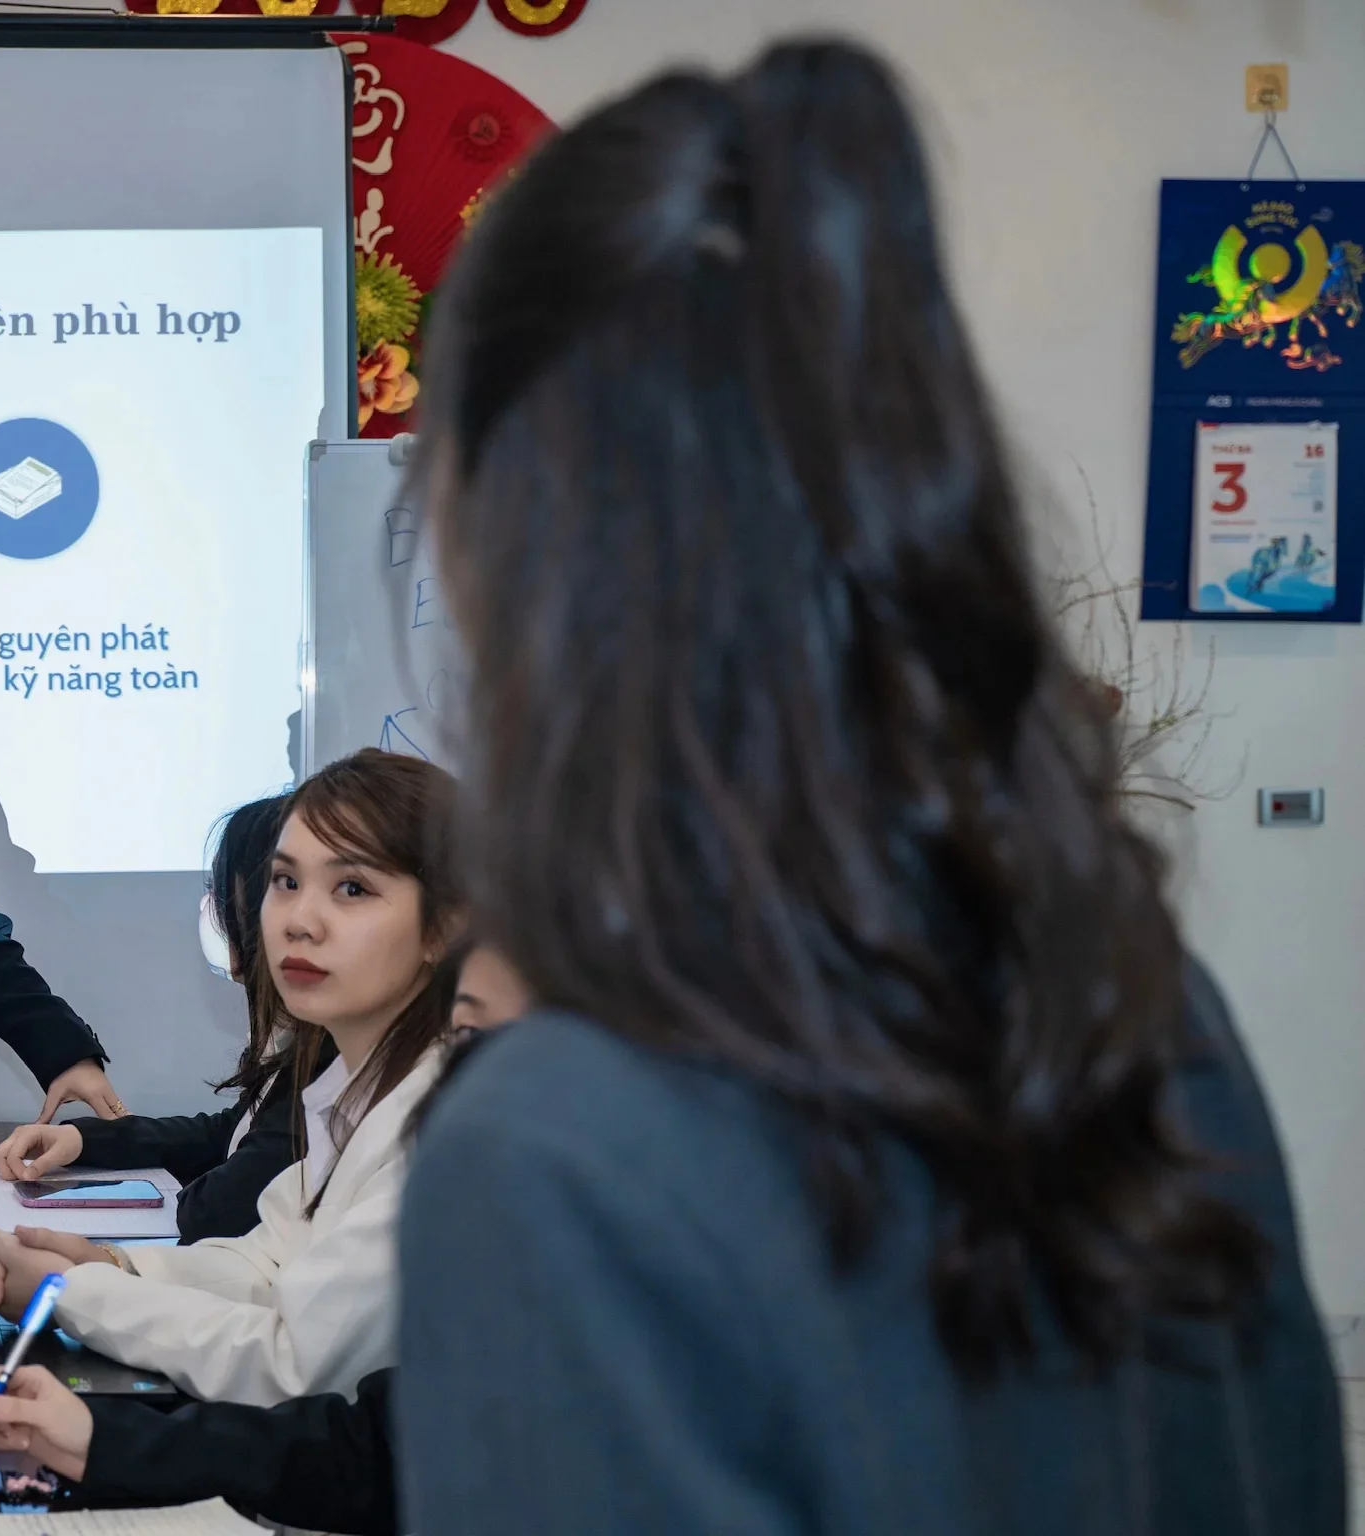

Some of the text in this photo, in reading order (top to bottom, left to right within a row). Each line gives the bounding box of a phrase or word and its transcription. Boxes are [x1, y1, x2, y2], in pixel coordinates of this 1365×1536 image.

[52, 302, 140, 344] phù
[156, 303, 242, 343] hợp
[1304, 443, 1325, 459] 16
[1212, 462, 1247, 514] 3
[100, 622, 170, 659] phát
[4, 664, 39, 700] kỹ
[47, 664, 123, 699] năng
[130, 662, 199, 691] toàn
